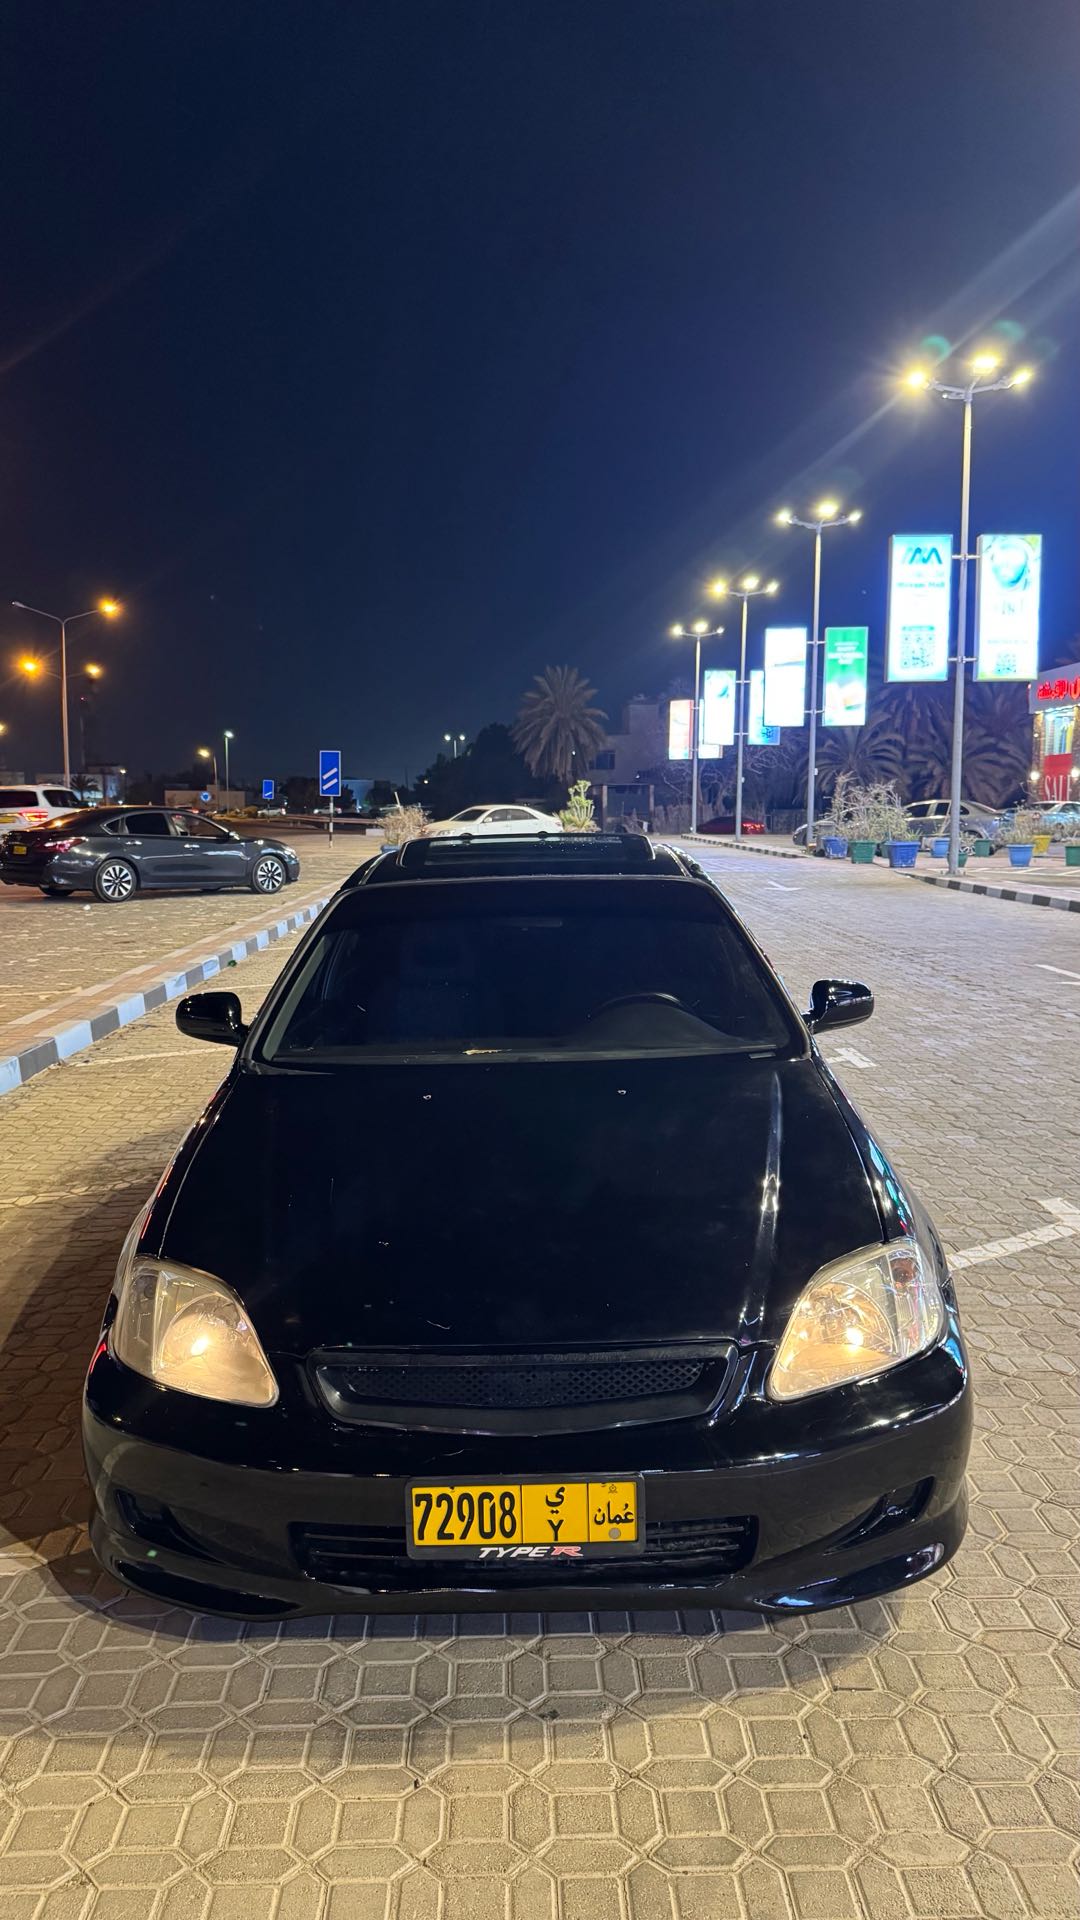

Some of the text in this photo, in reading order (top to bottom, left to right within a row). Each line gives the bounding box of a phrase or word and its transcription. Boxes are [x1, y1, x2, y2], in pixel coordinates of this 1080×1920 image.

[545, 1486, 565, 1514] ي
[415, 1491, 517, 1541] 72908
[548, 1519, 565, 1542] Y
[478, 1545, 583, 1558] TYPE R
